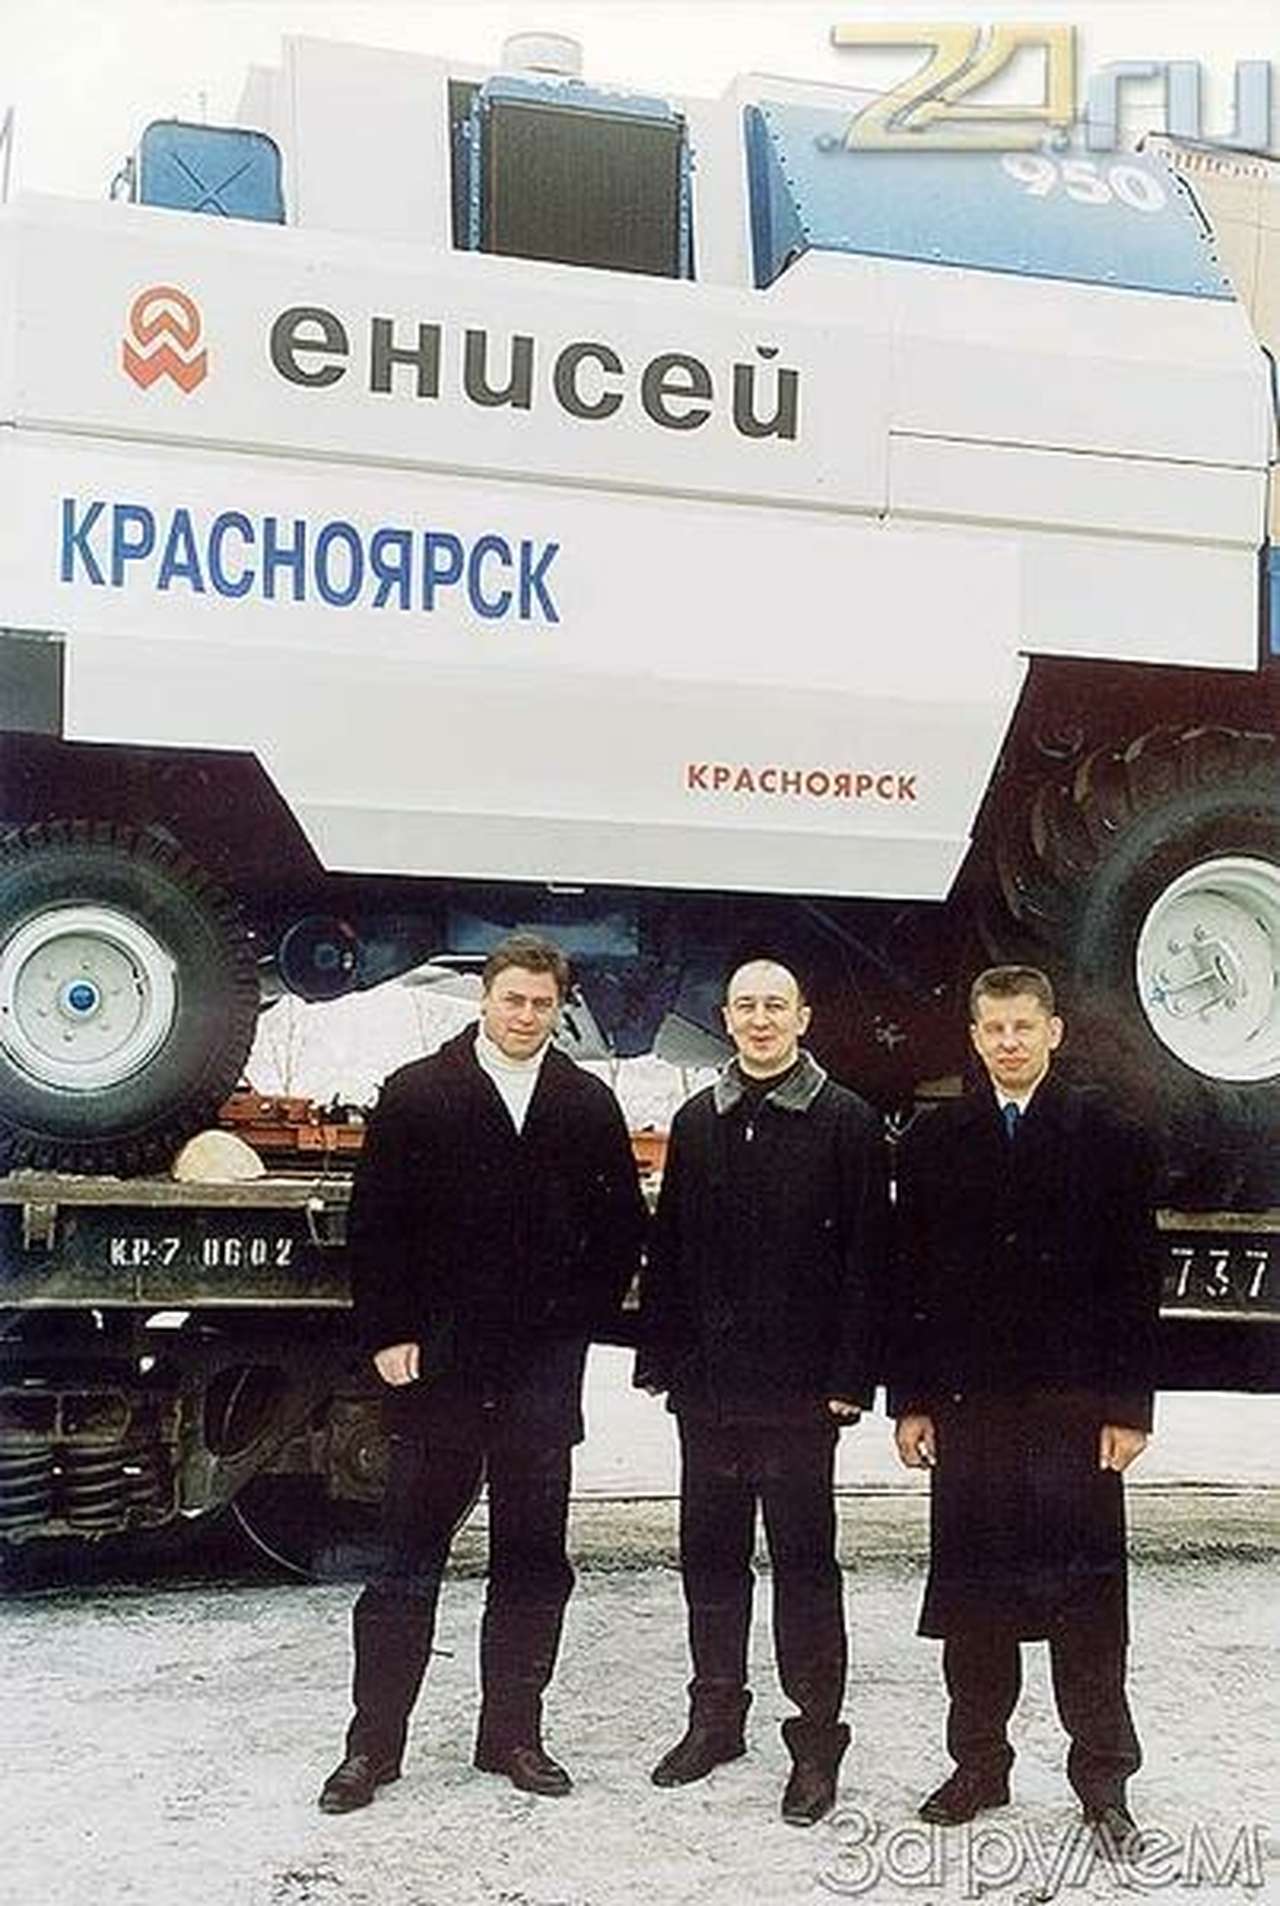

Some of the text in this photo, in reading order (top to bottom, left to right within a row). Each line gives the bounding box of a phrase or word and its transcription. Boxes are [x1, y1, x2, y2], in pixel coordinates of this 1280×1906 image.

[1000, 152, 1168, 212] 950
[60, 497, 562, 623] КРАСНОЯРСК
[687, 764, 917, 801] КРАСНОЯРСК
[1170, 1247, 1269, 1298] 737
